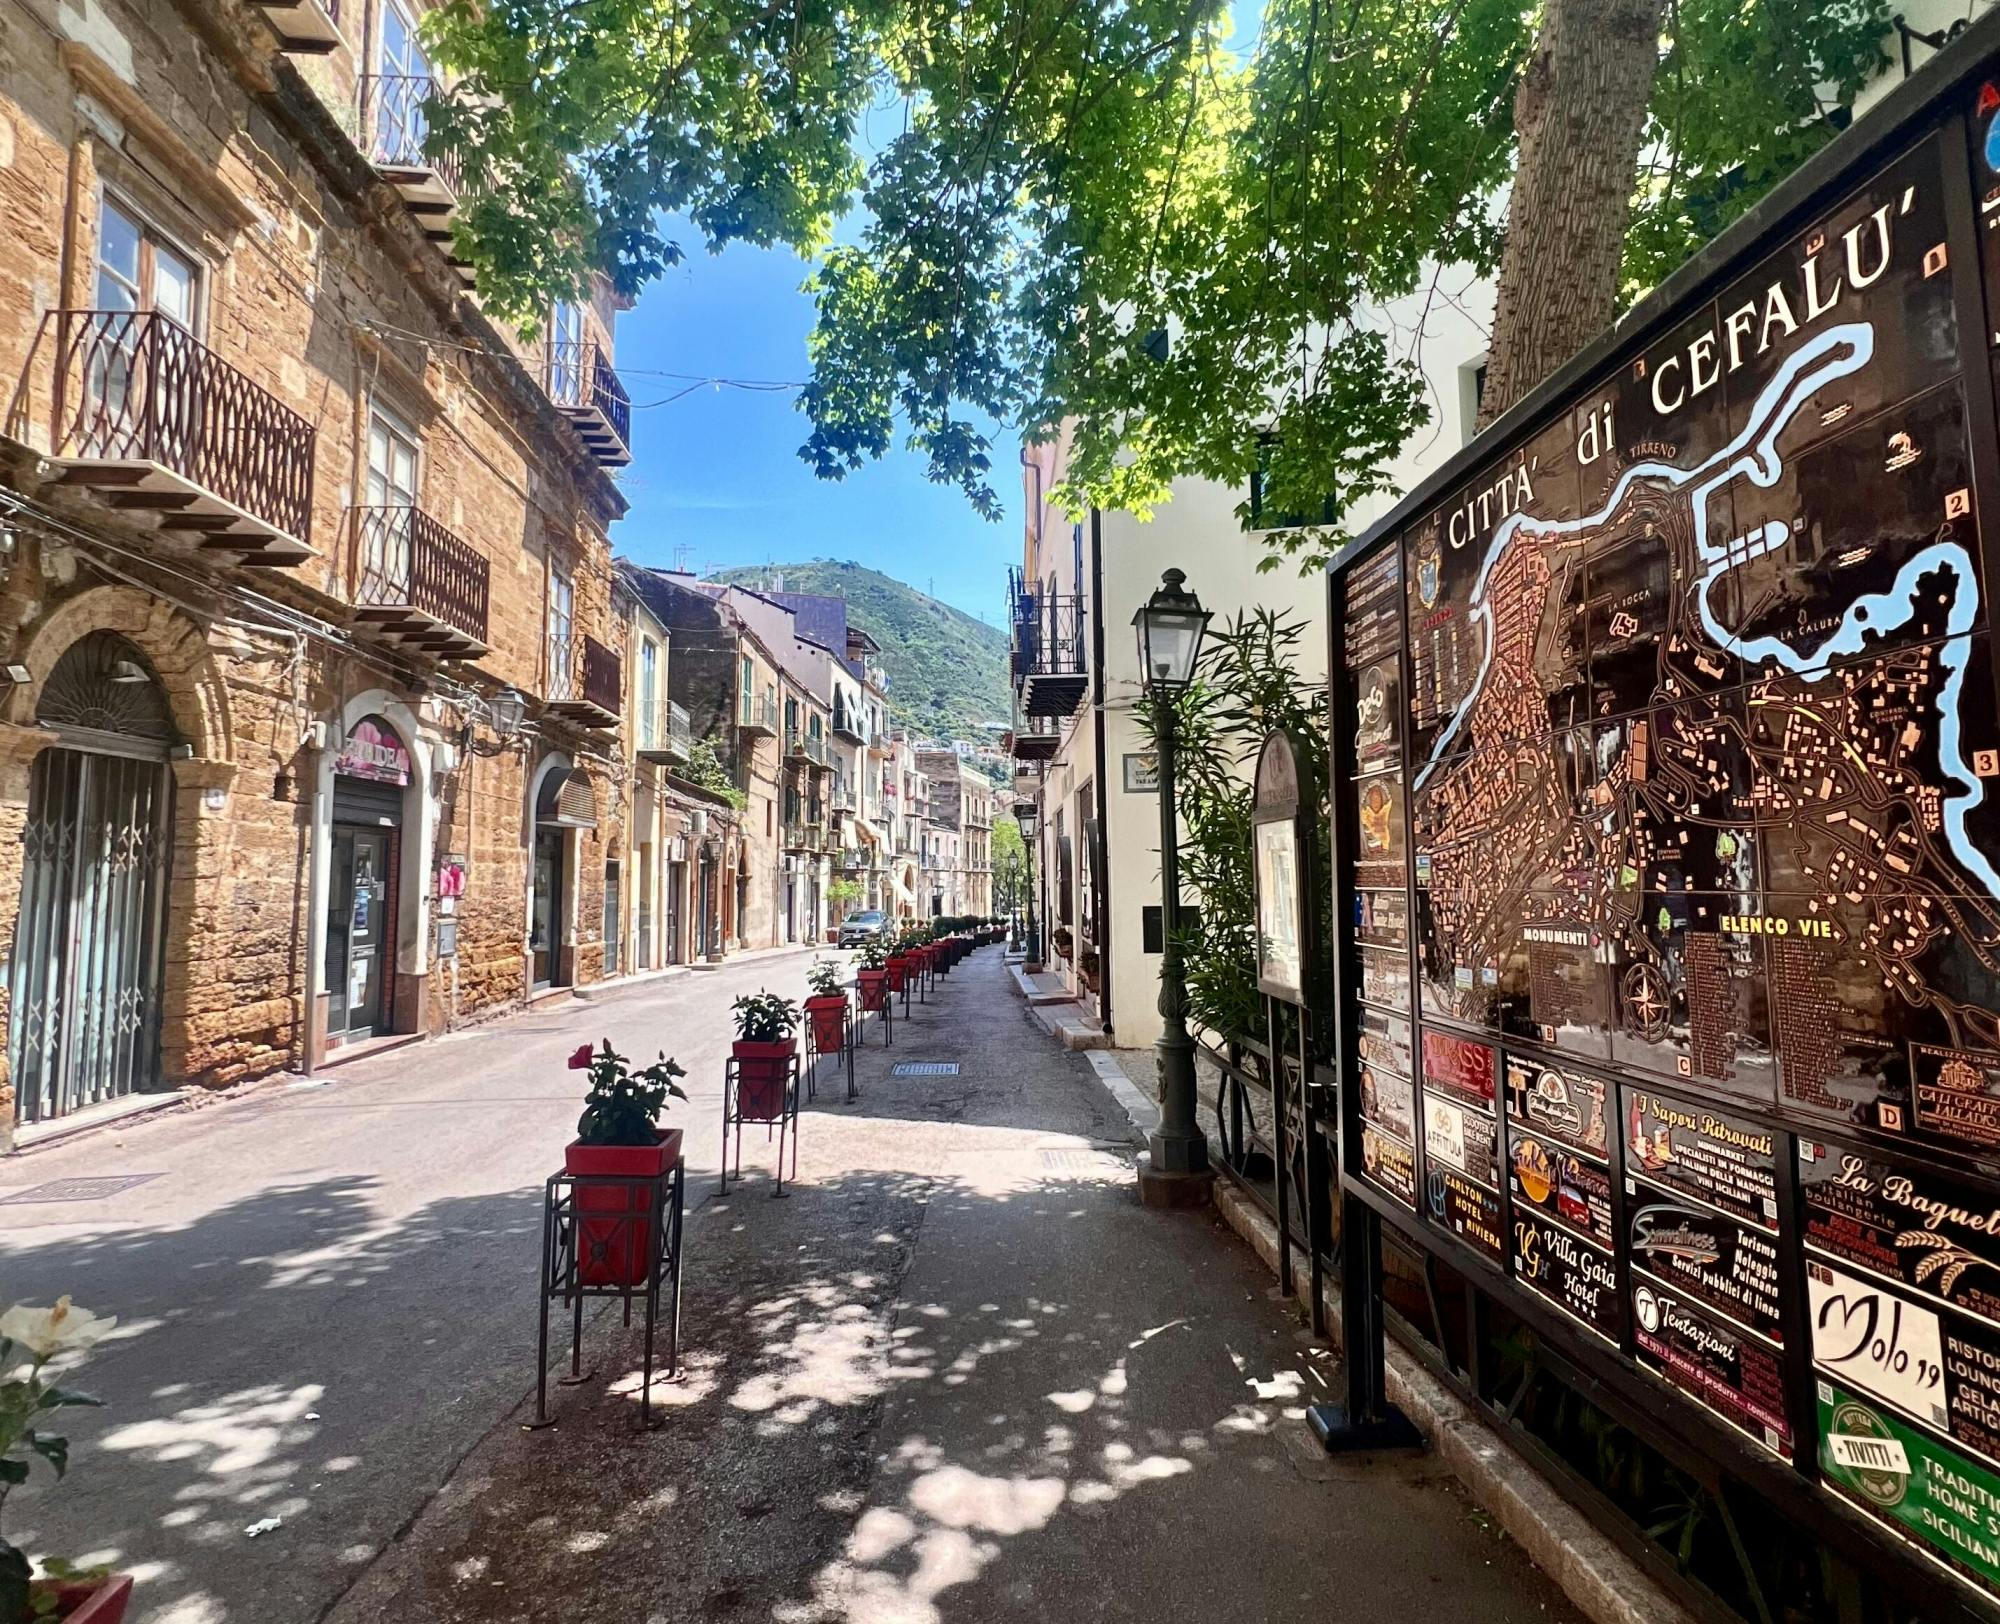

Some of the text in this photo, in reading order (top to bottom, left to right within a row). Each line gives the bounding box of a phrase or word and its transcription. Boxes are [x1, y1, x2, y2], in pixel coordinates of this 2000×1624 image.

[1449, 186, 1915, 549] CITTA' di CEFALU'
[1629, 441, 1677, 459] TIRRENO
[1951, 496, 1963, 511] 2
[1780, 615, 1841, 641] LA CALURA
[1981, 754, 1991, 771] 3
[1523, 927, 1588, 946] MONUMENTI
[1722, 915, 1832, 938] ELENCO VIE
[1679, 1058, 1689, 1073] C
[1920, 1046, 1981, 1063] REALIZZATO
[1463, 1114, 1490, 1134] SCOOTER
[1652, 1098, 1697, 1131] Sapori
[1700, 1114, 1773, 1155] Ritrovati
[1884, 1108, 1898, 1125] D
[1476, 1131, 1492, 1148] RENT
[1697, 1139, 1746, 1163] MINIMARKET
[1675, 1143, 1774, 1187] SPECIALISTI IN FORMAGGI
[1681, 1157, 1708, 1175] SALUMI
[1710, 1165, 1734, 1185] DELLE
[1736, 1173, 1776, 1201] MADONIE
[1832, 1155, 1876, 1194] La
[1445, 1173, 1483, 1206] CARLTON
[1696, 1174, 1751, 1204] VINI SICILIANI
[1821, 1181, 1875, 1209] italian
[1455, 1195, 1483, 1222] HOTEL
[1805, 1188, 1896, 1229] boulangerie
[1466, 1218, 1502, 1251] RIVIERA
[1737, 1229, 1777, 1260] Turismo
[1544, 1230, 1577, 1268] Villa
[1581, 1252, 1616, 1290] Gaia
[1735, 1249, 1778, 1280] Noleggio
[1563, 1272, 1600, 1307] Hotel
[1672, 1253, 1701, 1280] Servizi
[1703, 1270, 1741, 1299] pubblici
[1742, 1288, 1752, 1306] di
[1754, 1294, 1780, 1320] linea
[1733, 1265, 1779, 1298] Pulmann
[1640, 1299, 1653, 1322] T
[1658, 1297, 1735, 1362] Tentazioni
[1815, 1294, 1940, 1390] Molo 19
[1669, 1350, 1695, 1374] piacere
[1695, 1366, 1704, 1380] di
[1843, 1440, 1893, 1467] TIVITTI
[1928, 1480, 1981, 1526] HOME
